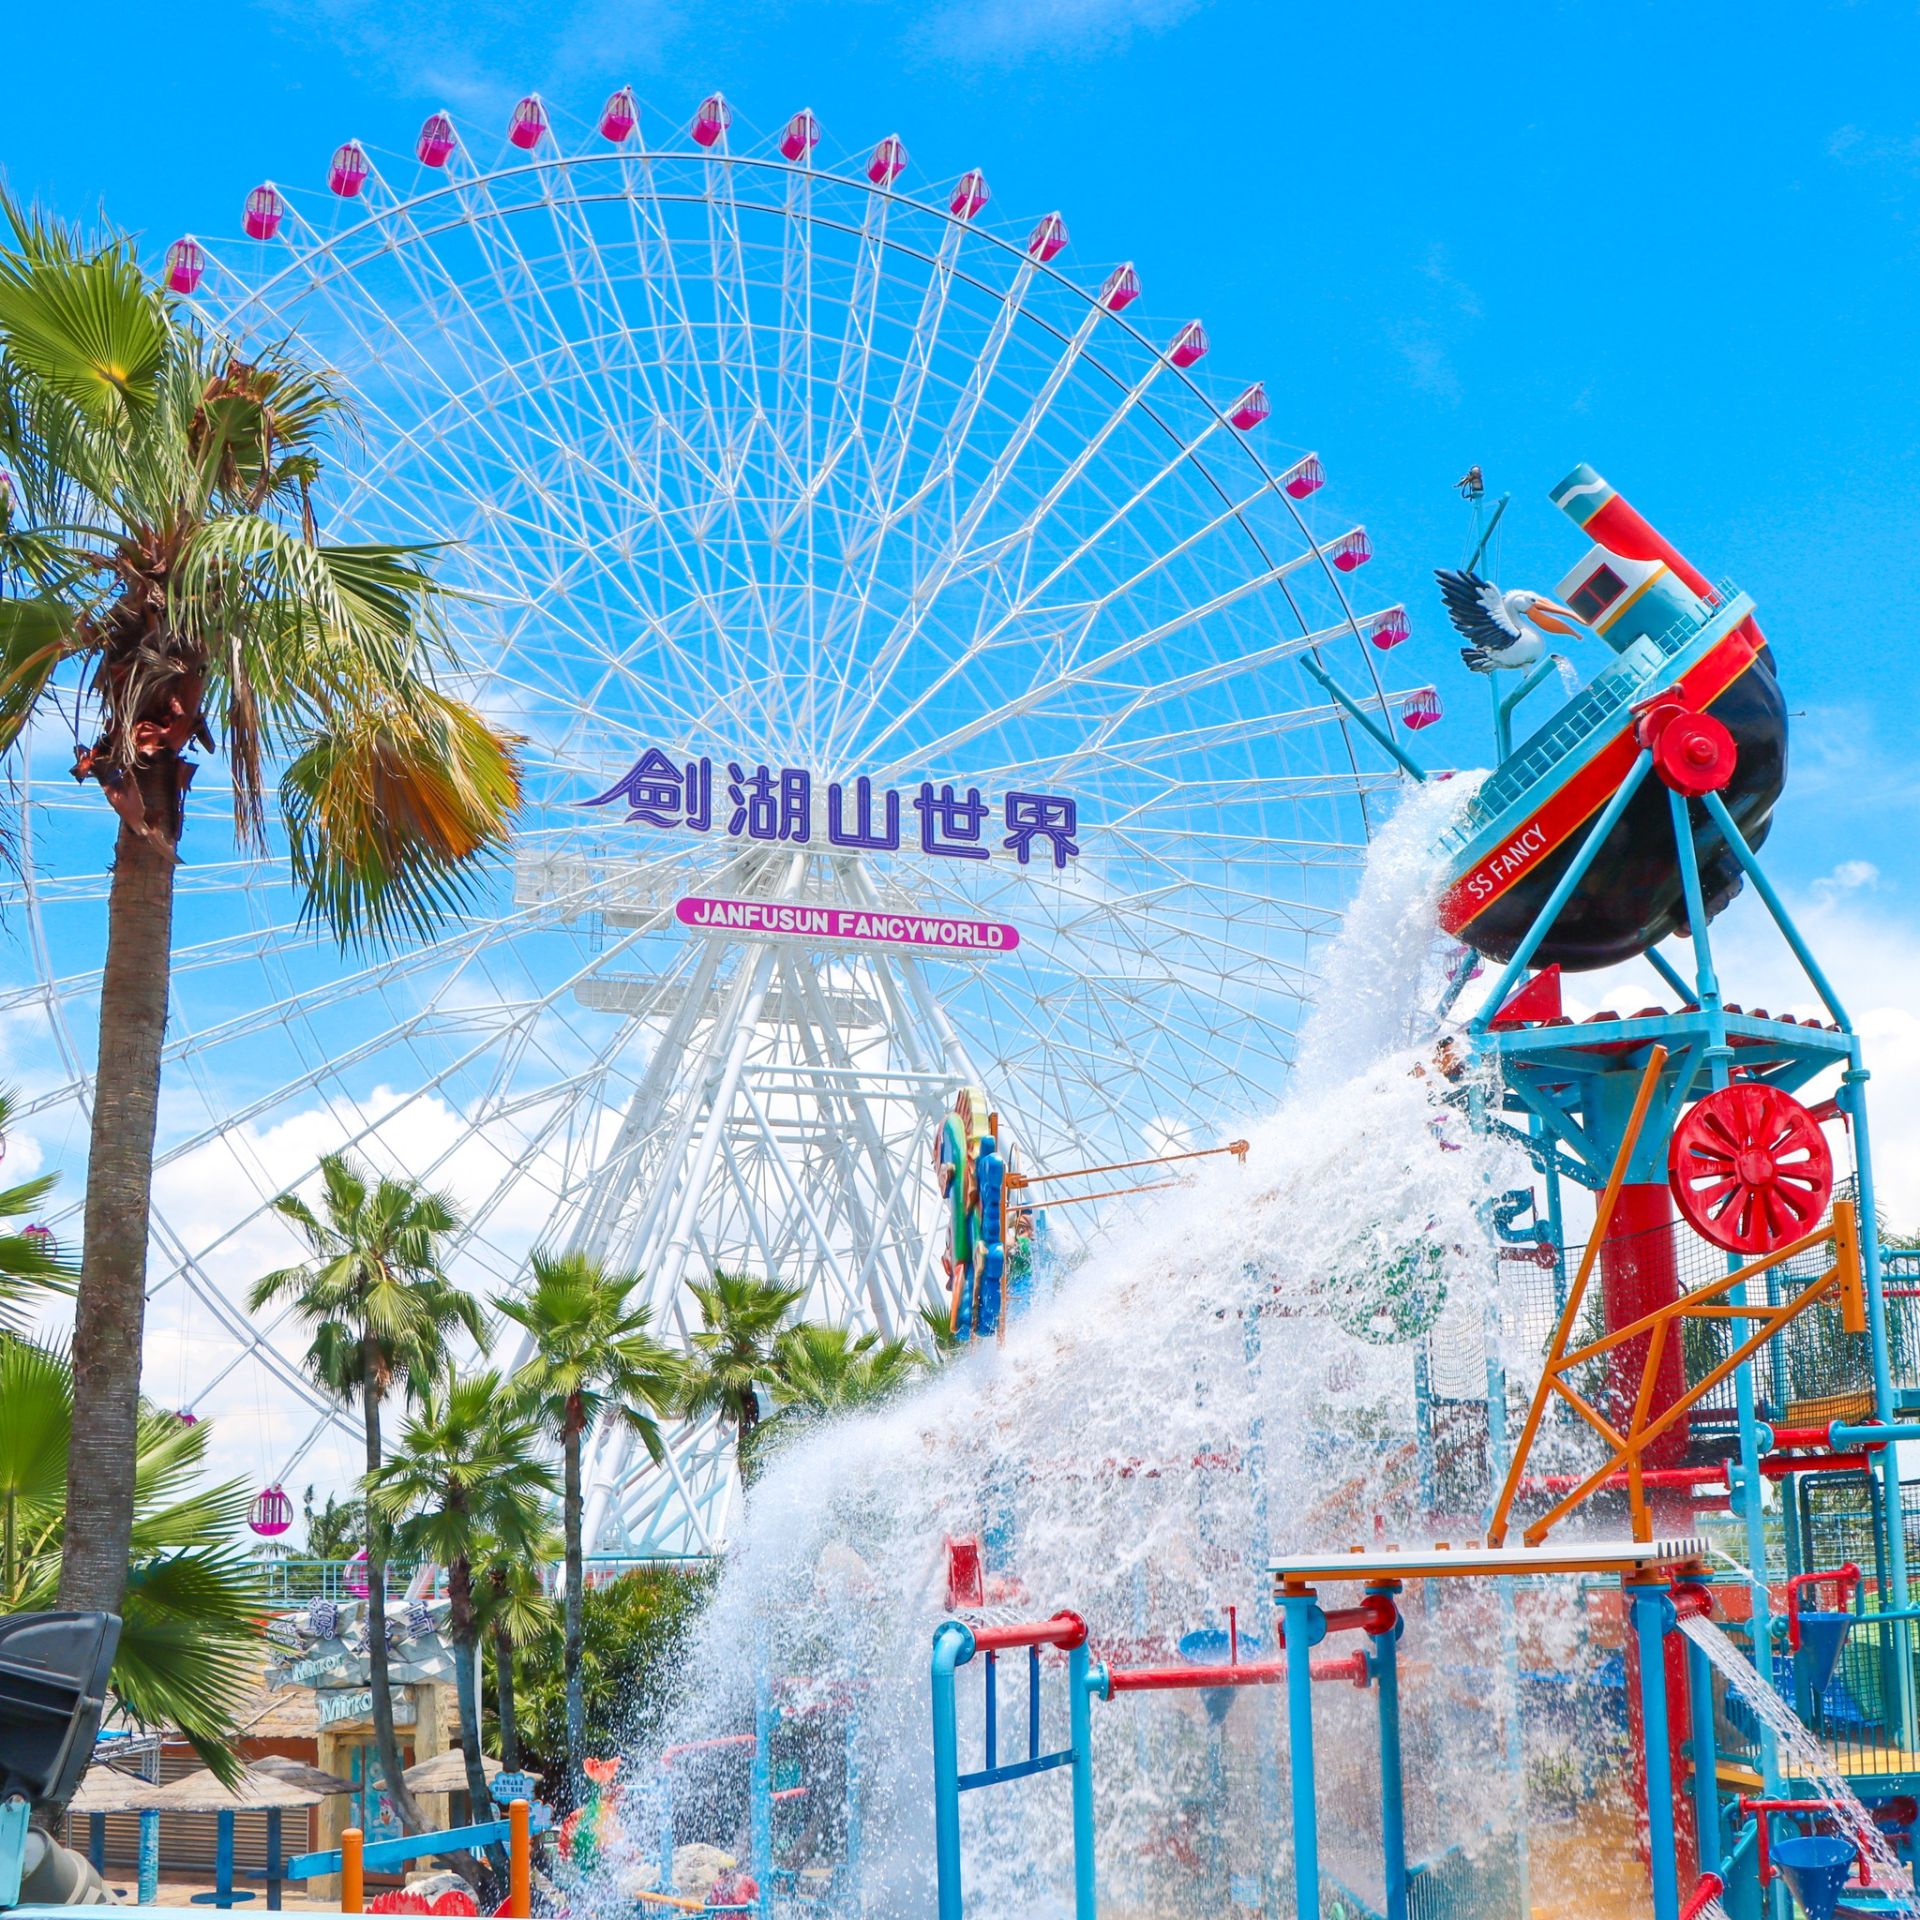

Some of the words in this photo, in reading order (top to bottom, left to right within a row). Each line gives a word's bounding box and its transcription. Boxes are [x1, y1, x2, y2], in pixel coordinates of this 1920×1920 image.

[1468, 873, 1493, 899] SS
[1489, 823, 1546, 880] FANCY
[694, 902, 828, 933] JANFUSUN
[838, 913, 1003, 947] FANCYWORLD
[320, 1691, 373, 1724] Mirro
